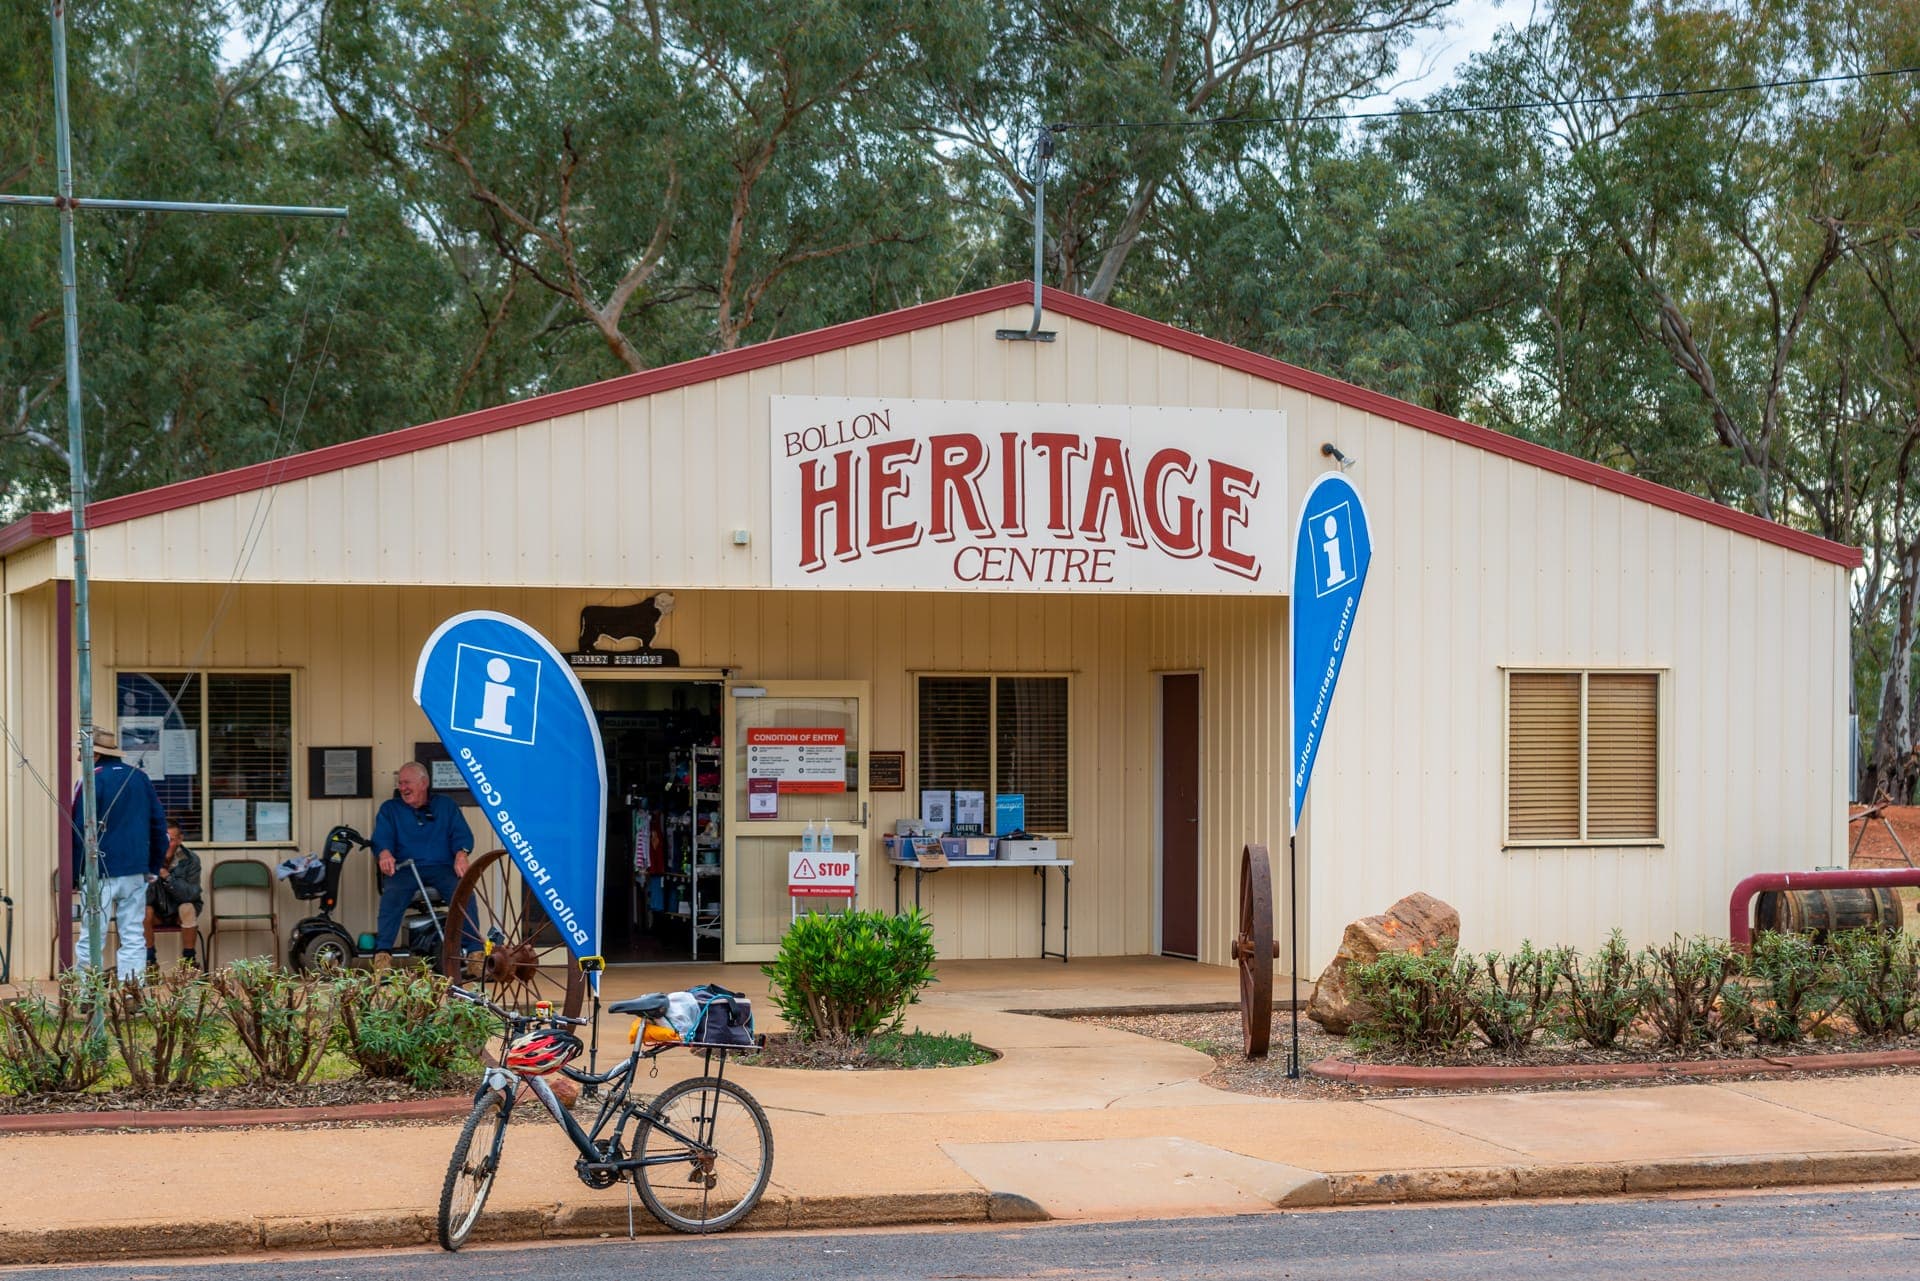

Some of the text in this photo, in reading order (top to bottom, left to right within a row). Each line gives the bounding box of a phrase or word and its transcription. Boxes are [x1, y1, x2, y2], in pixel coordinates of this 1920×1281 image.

[784, 409, 891, 458] BOLLON
[799, 432, 1262, 582] HERITAGE
[953, 546, 1116, 583] CENTRE
[571, 655, 663, 664] BOLLON HERITAGE
[1296, 596, 1354, 788] Bollon Heritage Centre
[753, 733, 839, 742] CONDITION OF ENTRY
[818, 863, 850, 876] STOP
